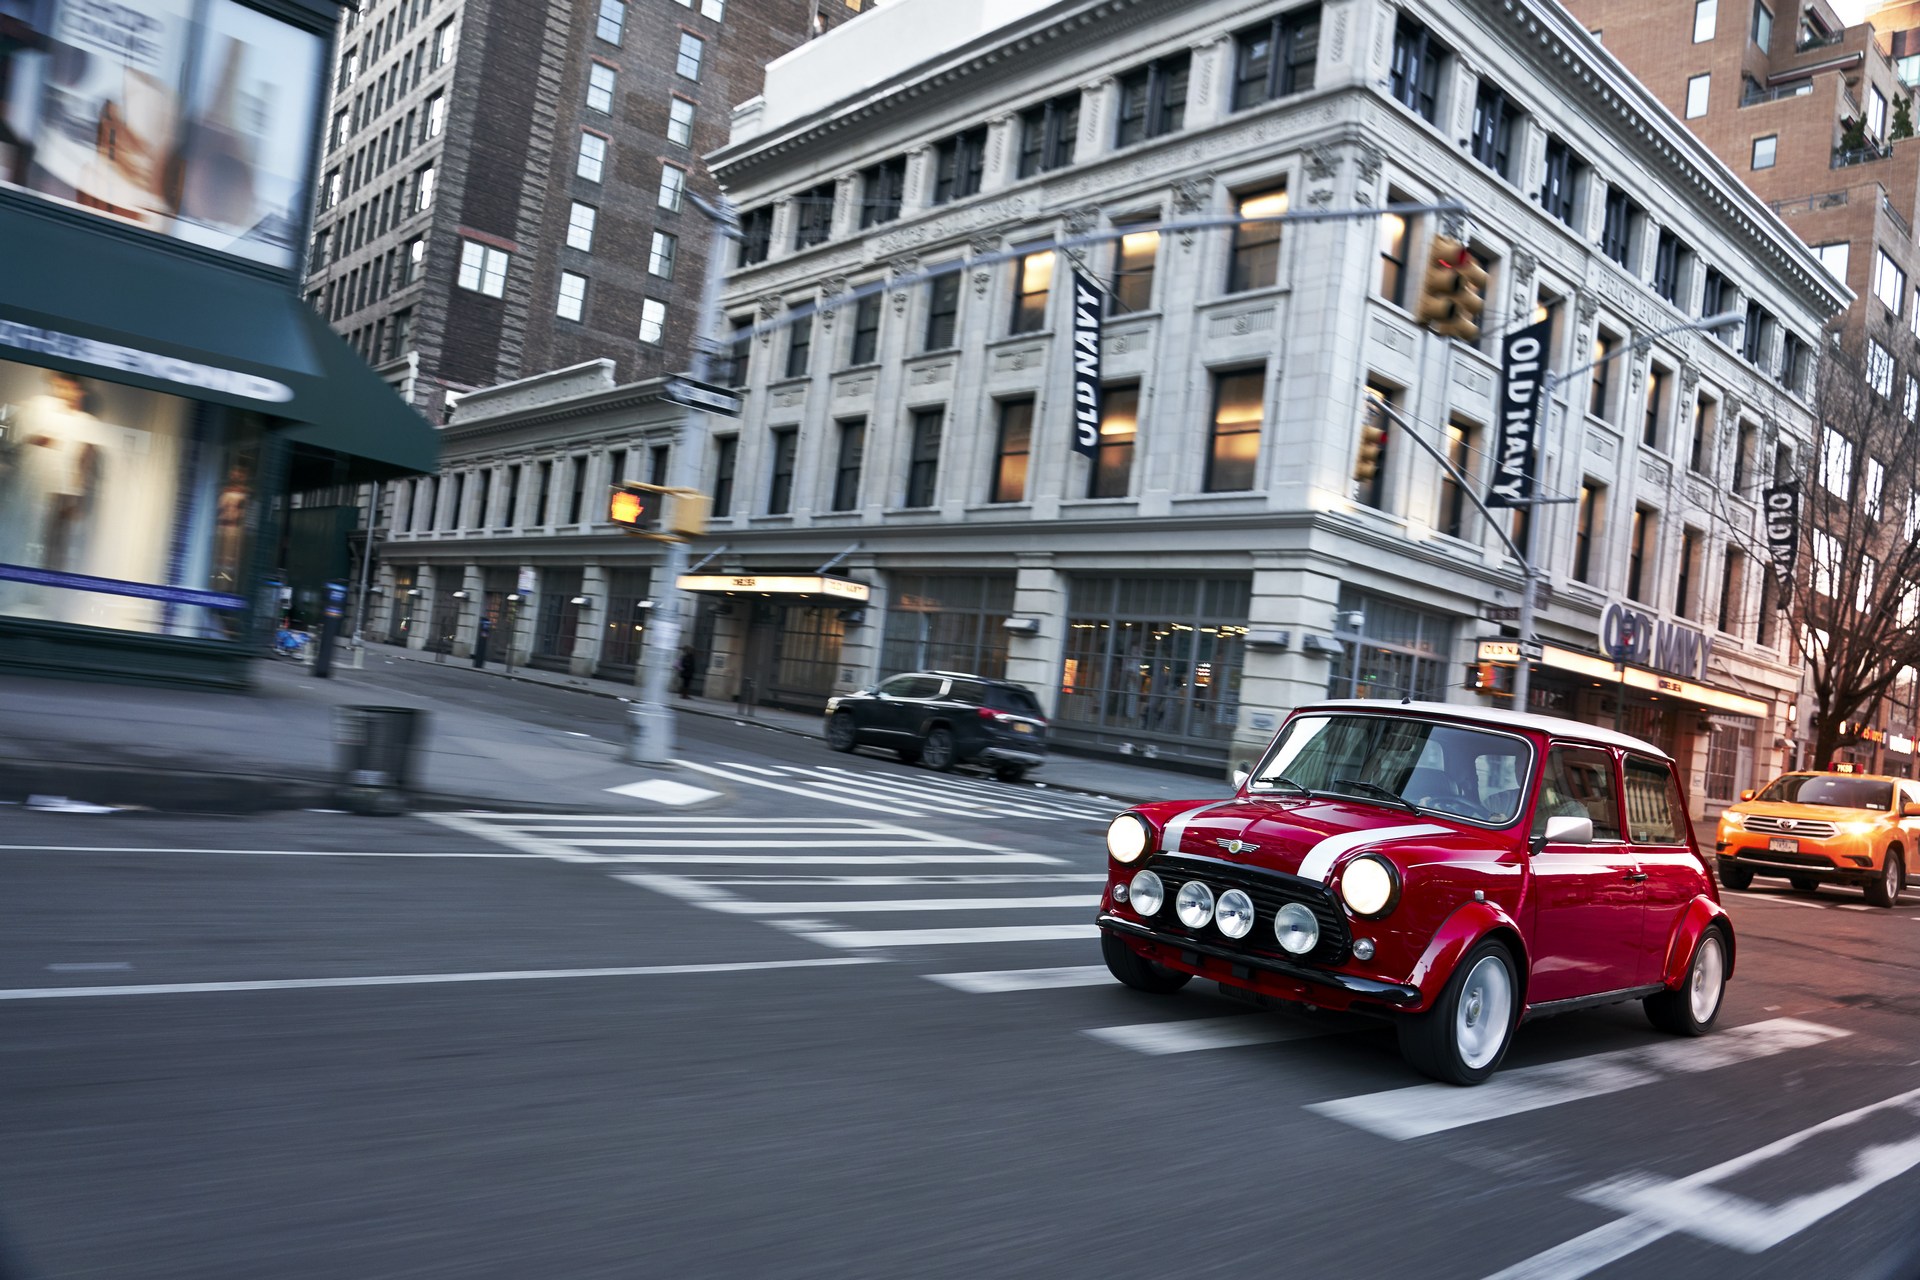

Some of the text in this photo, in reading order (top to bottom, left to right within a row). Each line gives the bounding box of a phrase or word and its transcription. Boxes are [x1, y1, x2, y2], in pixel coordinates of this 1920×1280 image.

[1074, 282, 1100, 379] NAVY
[1492, 336, 1541, 500] OLD NAVY
[1768, 492, 1792, 541] OLD
[1651, 619, 1714, 681] NAVY
